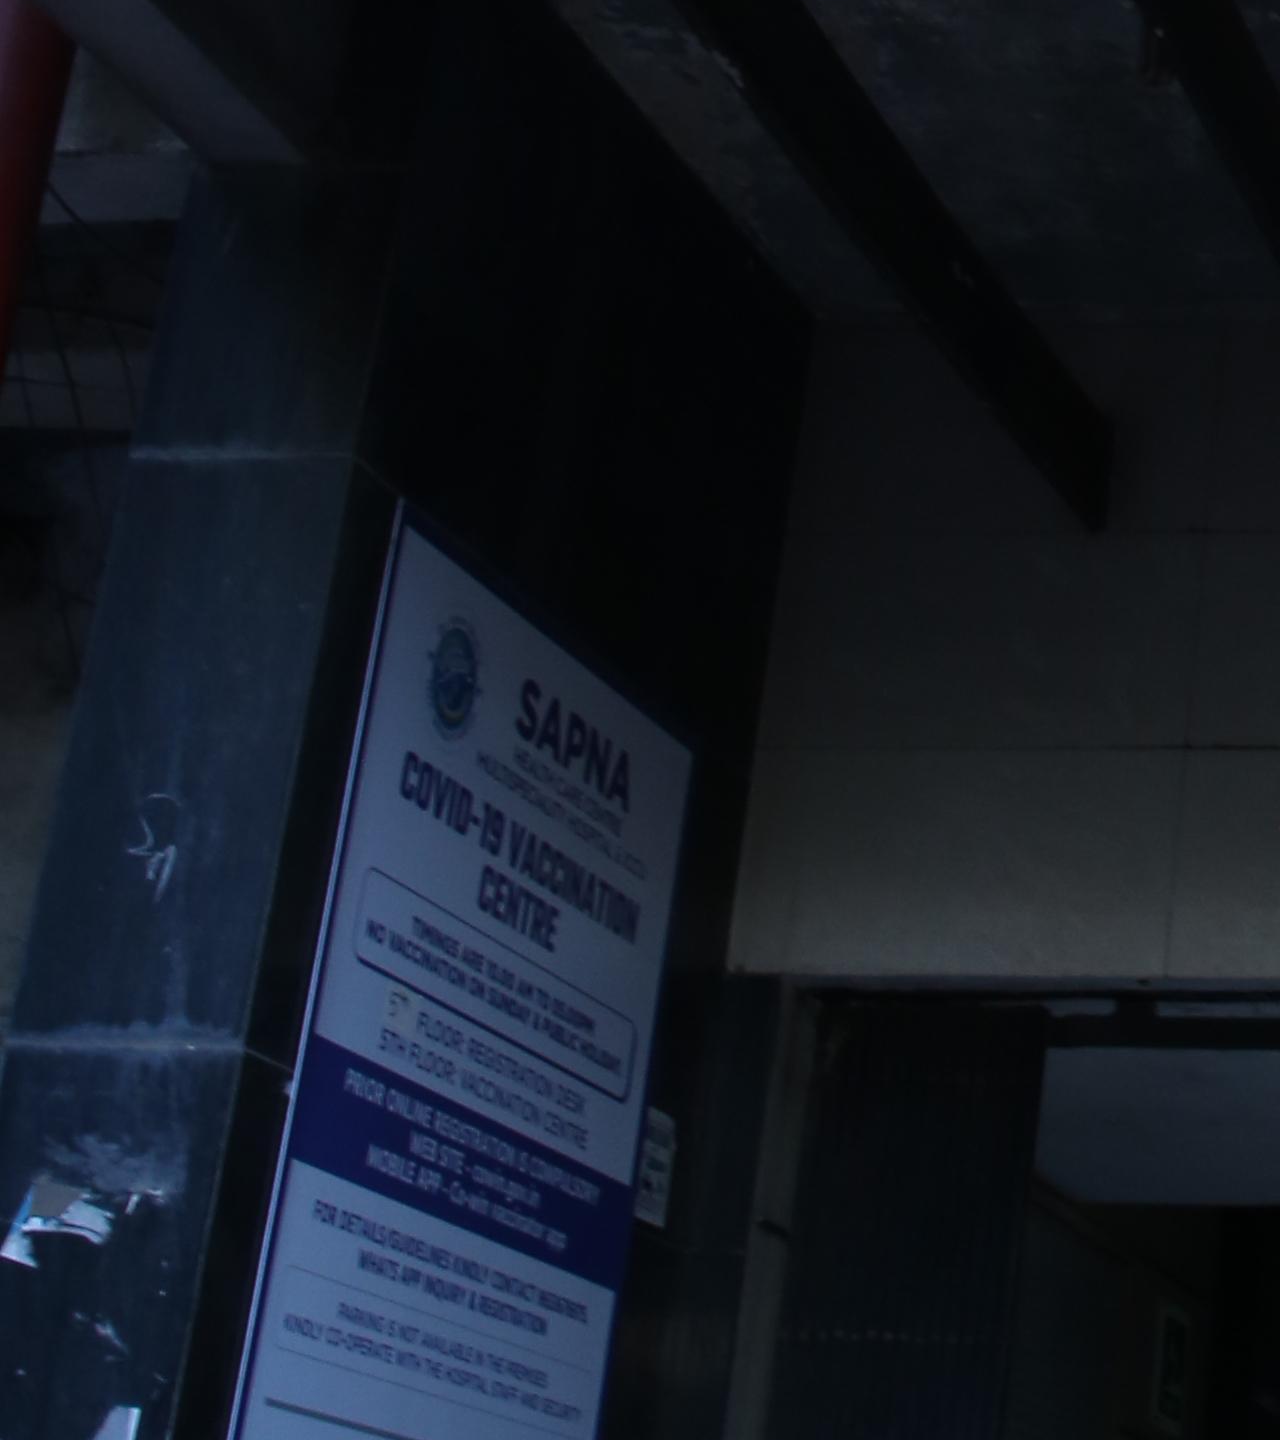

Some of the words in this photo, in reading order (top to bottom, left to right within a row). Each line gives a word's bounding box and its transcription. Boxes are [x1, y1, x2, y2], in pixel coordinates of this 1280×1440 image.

[515, 678, 629, 812] SAPNA
[400, 751, 505, 856] COVID-19
[510, 821, 640, 942] VACCINATION
[477, 865, 560, 952] CENTRE
[366, 920, 385, 944] NO
[389, 933, 466, 989] VACCINATION
[469, 977, 485, 998] ON
[488, 987, 530, 1022] SUNDAY
[344, 1068, 385, 1105] PRIOR
[386, 1088, 432, 1128] ONLINE
[468, 1038, 552, 1098] REGISTRATION
[461, 1074, 541, 1125] VACCINATION
[543, 1111, 588, 1150] CENTRE
[368, 1145, 415, 1183] MOBILE
[314, 1199, 337, 1225] FOR
